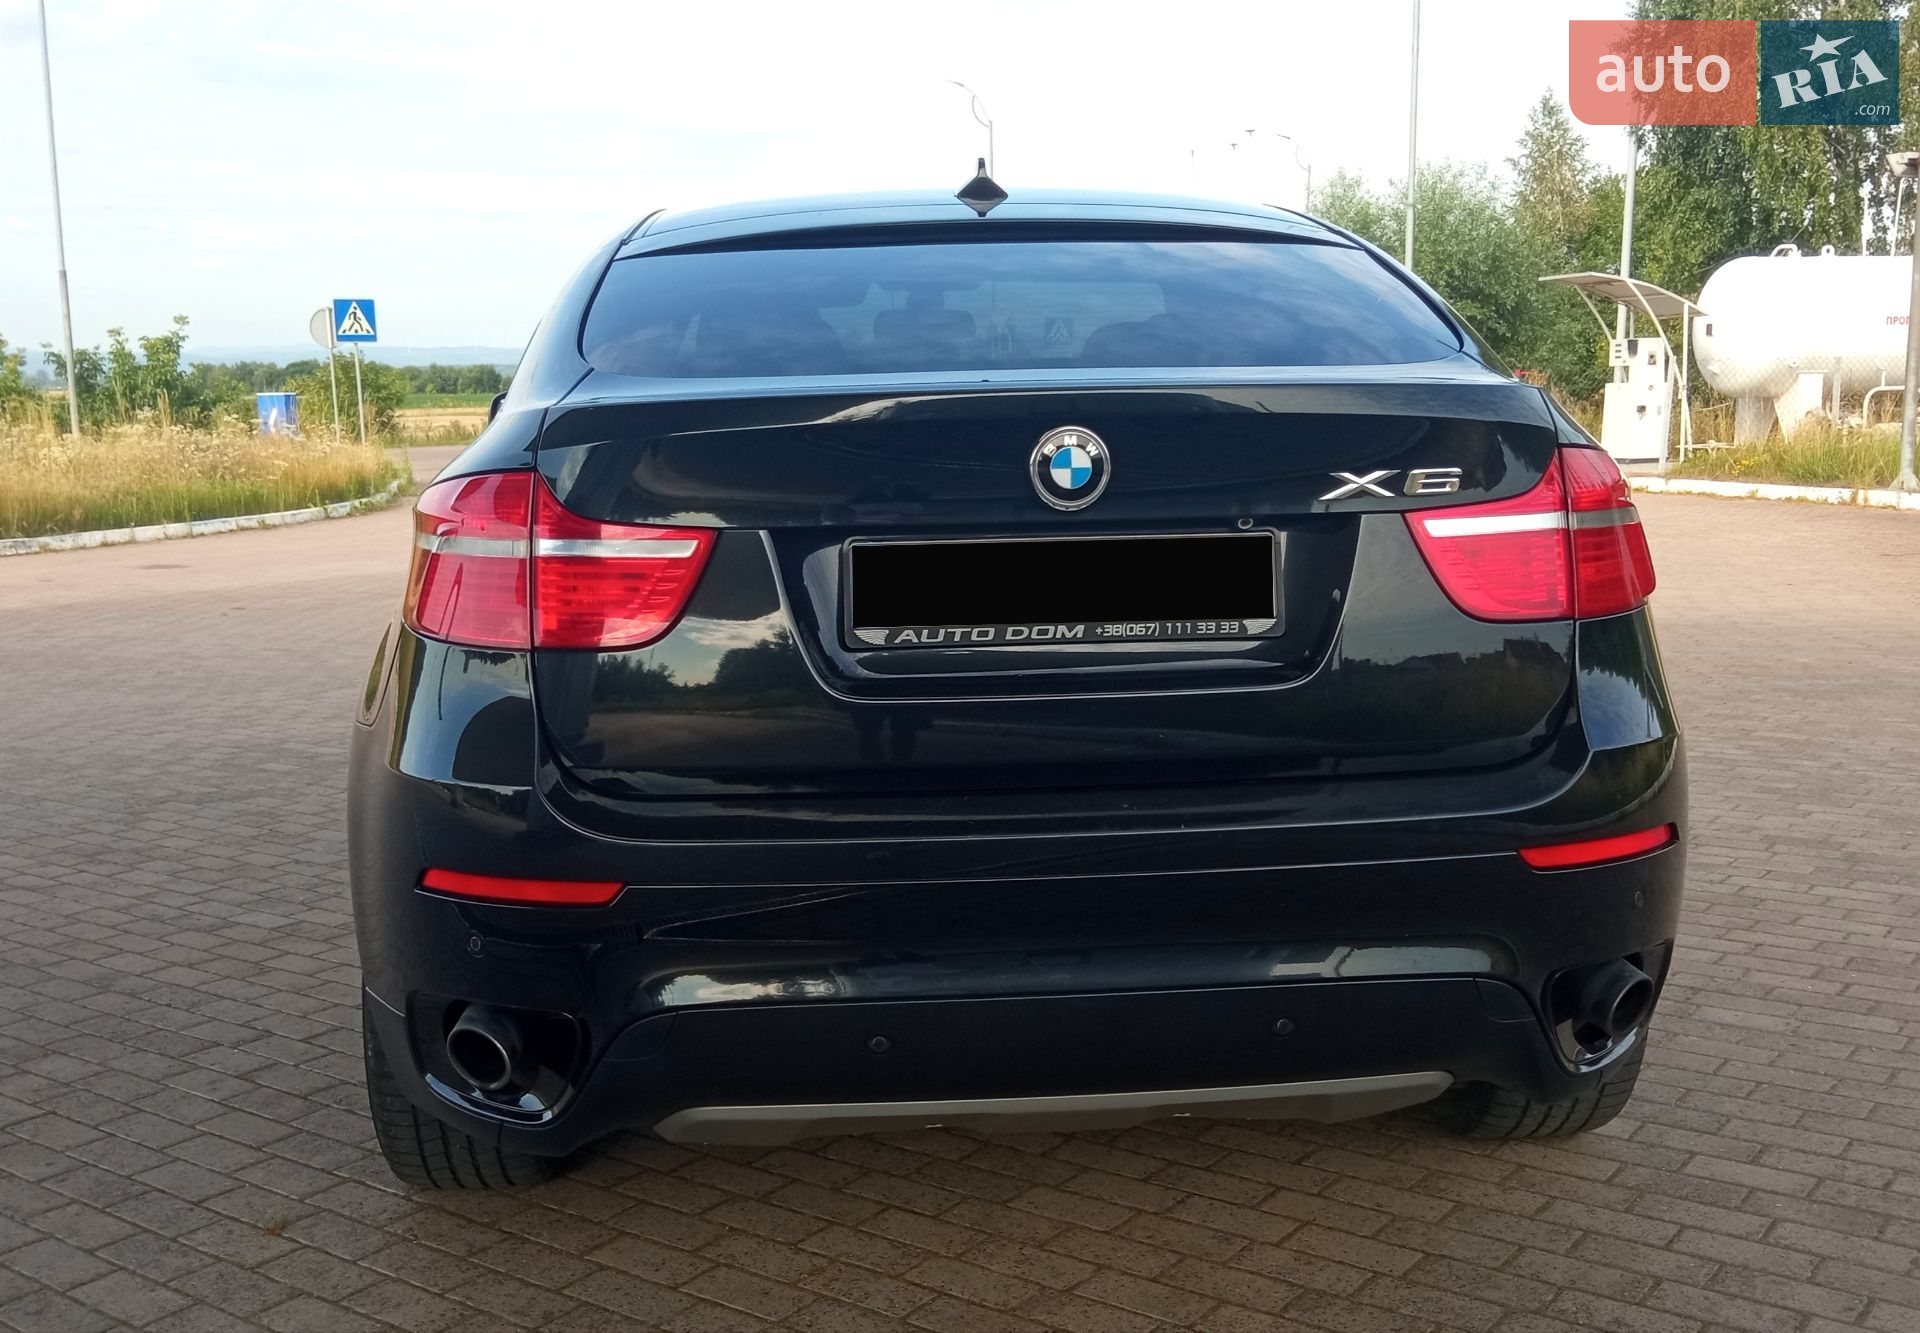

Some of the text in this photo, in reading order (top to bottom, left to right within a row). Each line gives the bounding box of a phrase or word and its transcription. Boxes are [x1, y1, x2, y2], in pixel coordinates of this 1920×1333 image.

[1043, 435, 1099, 457] BMW
[1318, 467, 1463, 501] X6
[894, 621, 1239, 643] AUTO DOM +38(067) 111 33 33
